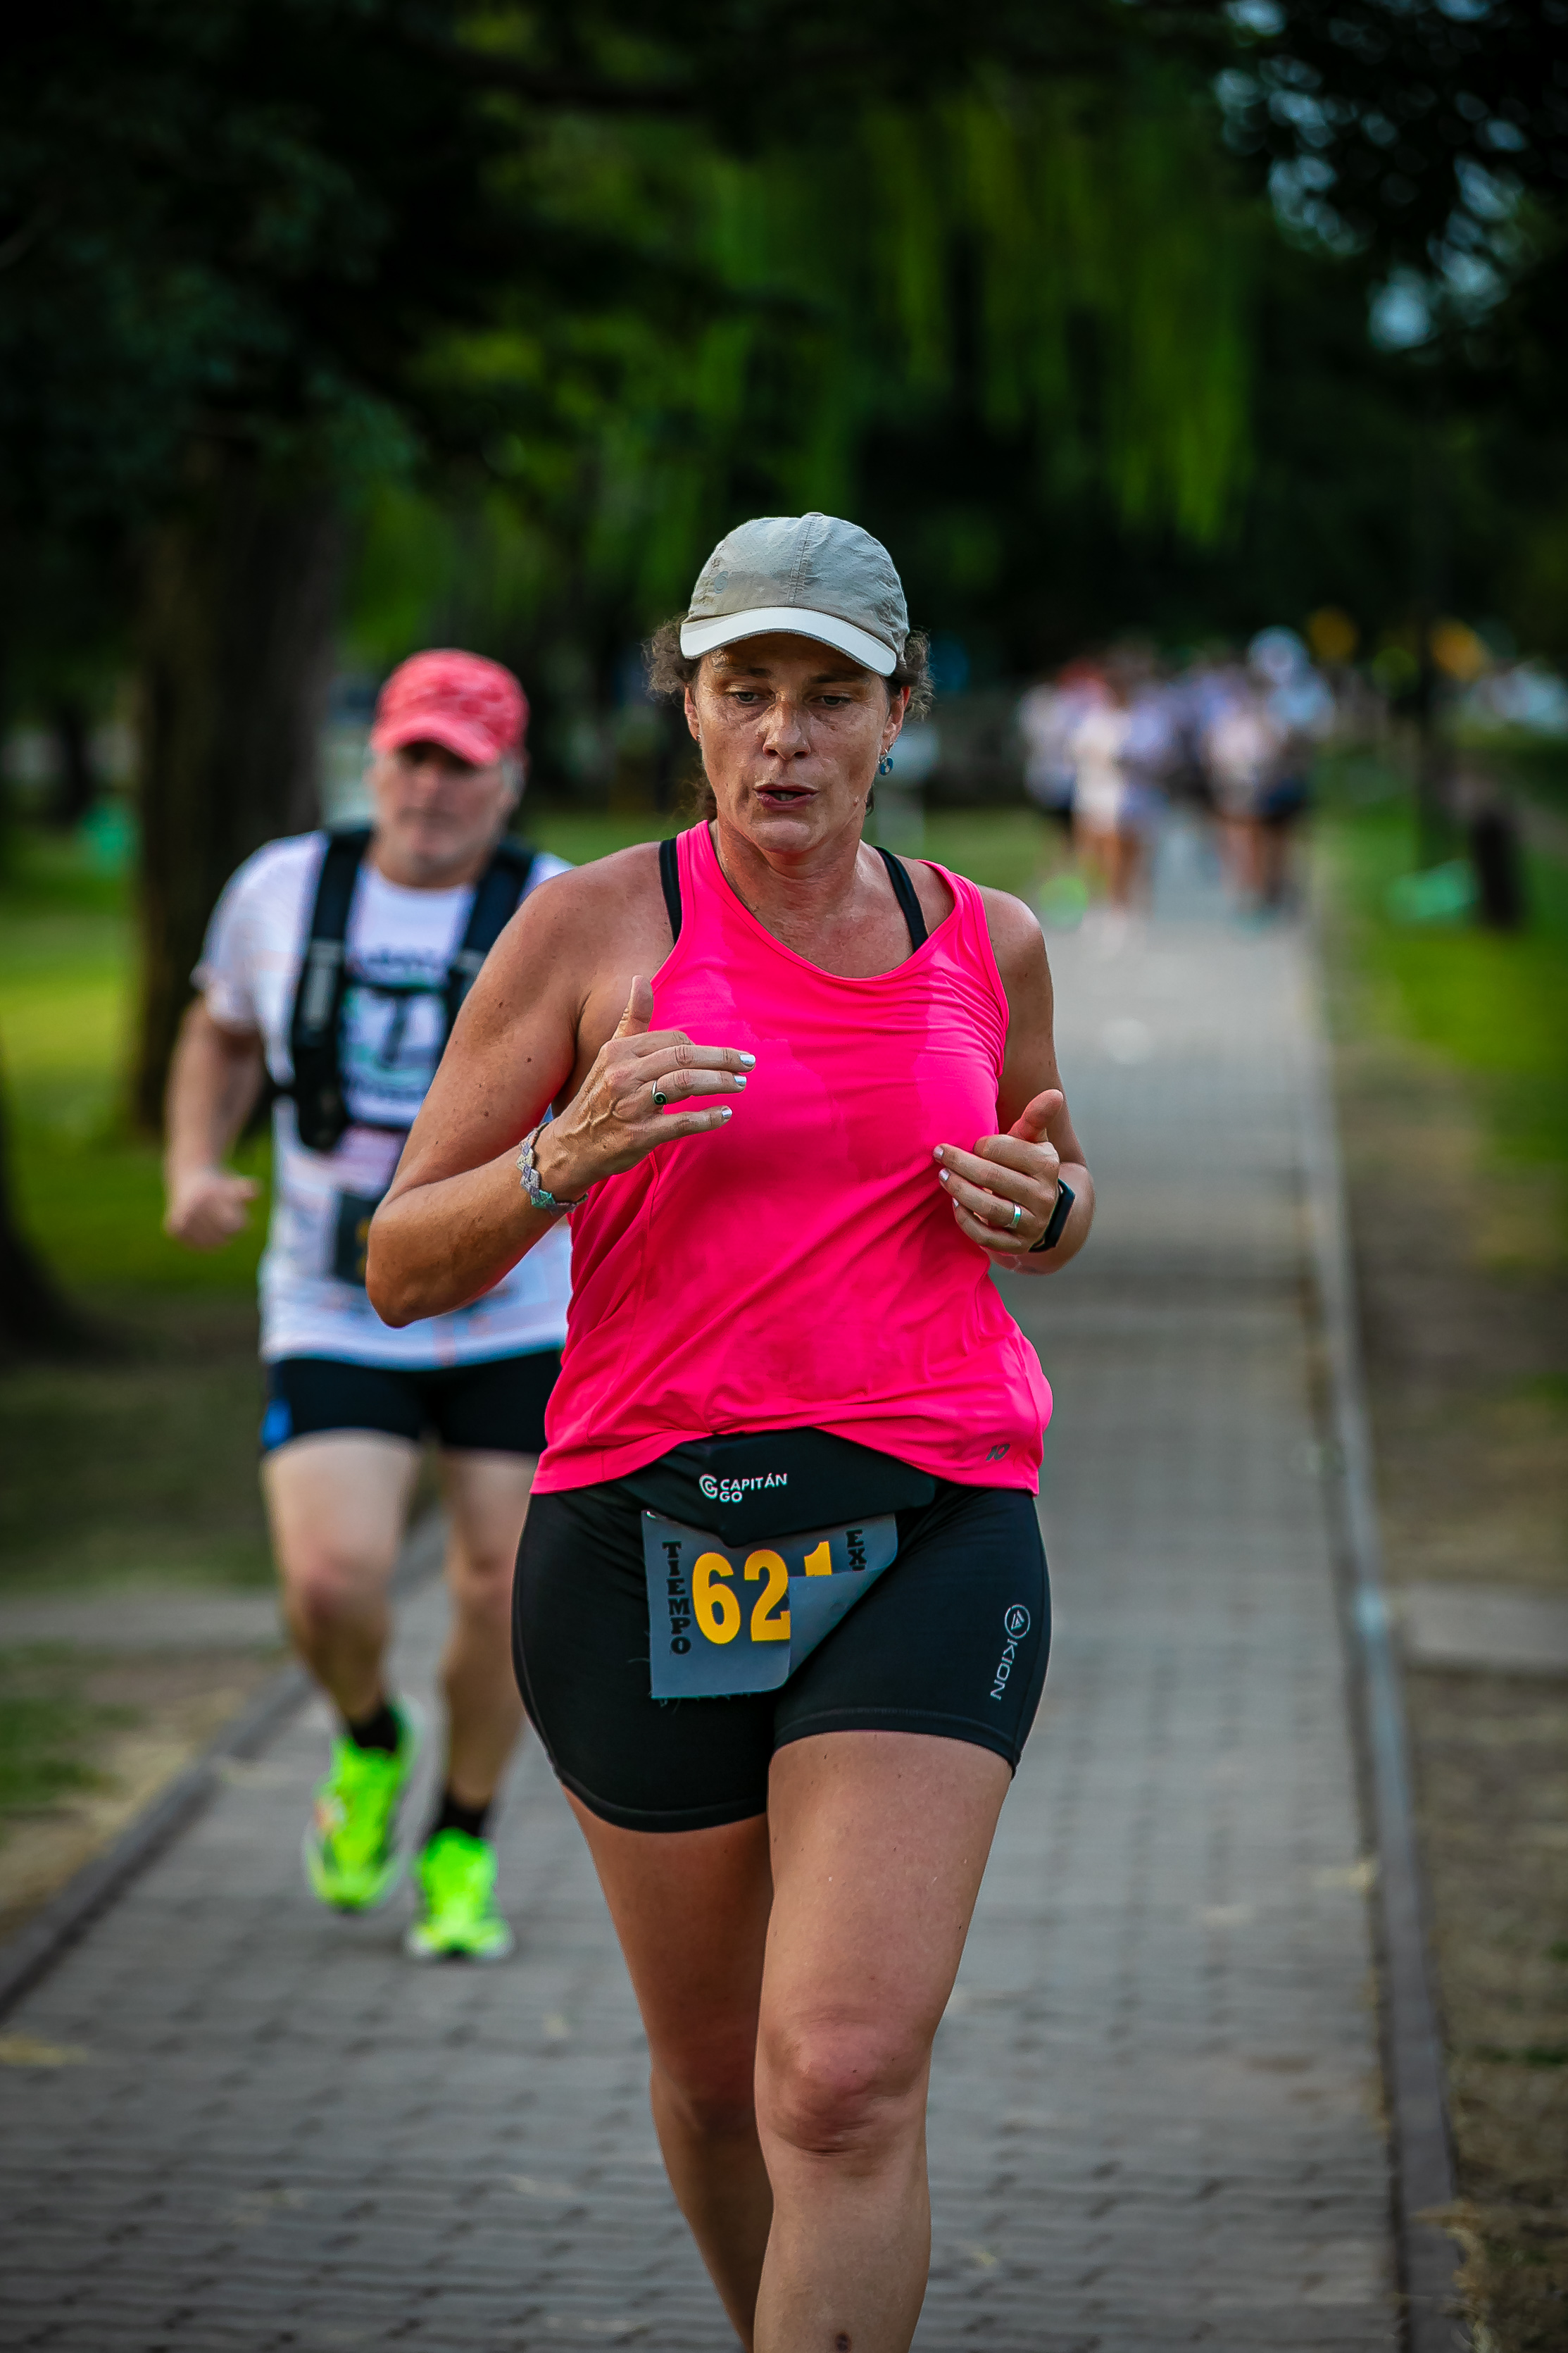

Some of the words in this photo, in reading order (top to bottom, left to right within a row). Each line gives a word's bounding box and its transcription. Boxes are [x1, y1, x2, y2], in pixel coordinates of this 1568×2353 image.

[720, 1473, 787, 1490] CAPITÁN
[720, 1491, 743, 1502] GO
[662, 1540, 691, 1654] TIEMPO
[990, 1638, 1018, 1701] KION
